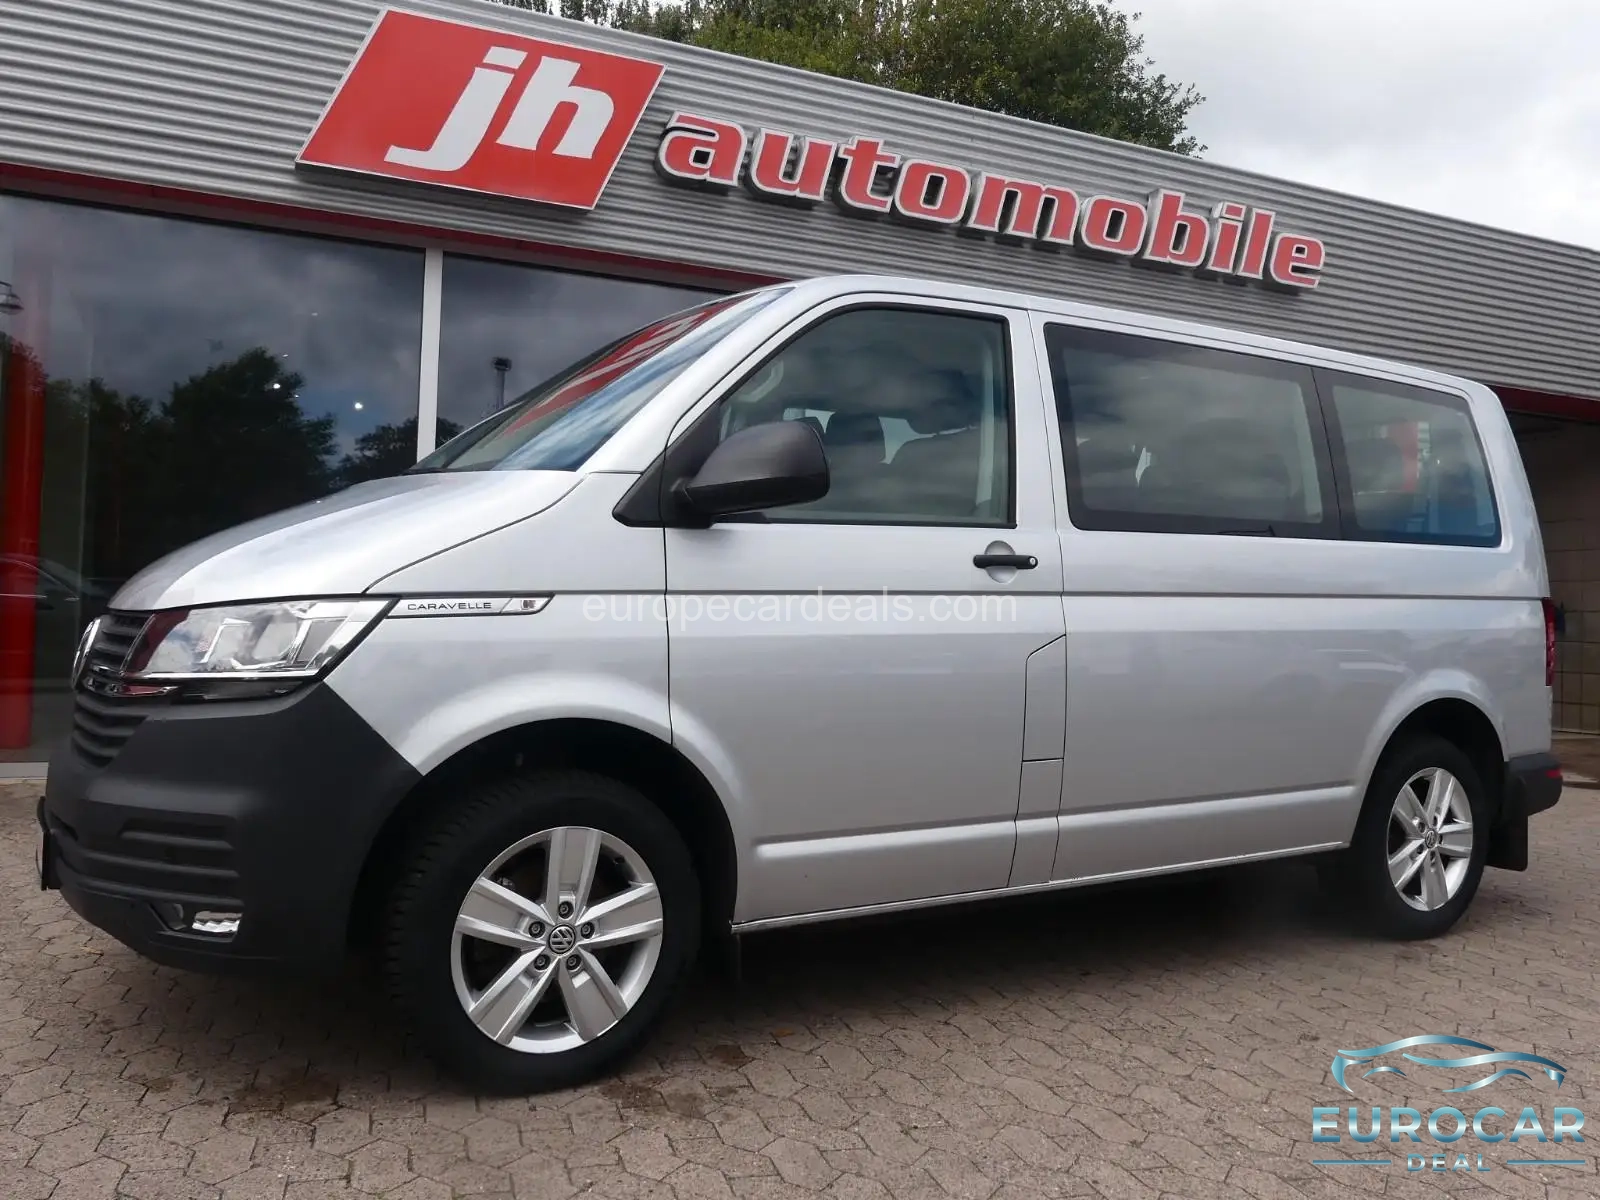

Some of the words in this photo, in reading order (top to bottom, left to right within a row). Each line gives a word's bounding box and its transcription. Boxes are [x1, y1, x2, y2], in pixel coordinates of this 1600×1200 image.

[383, 46, 614, 172] jh
[658, 111, 1326, 289] automobile
[407, 602, 492, 611] CARAVELLE
